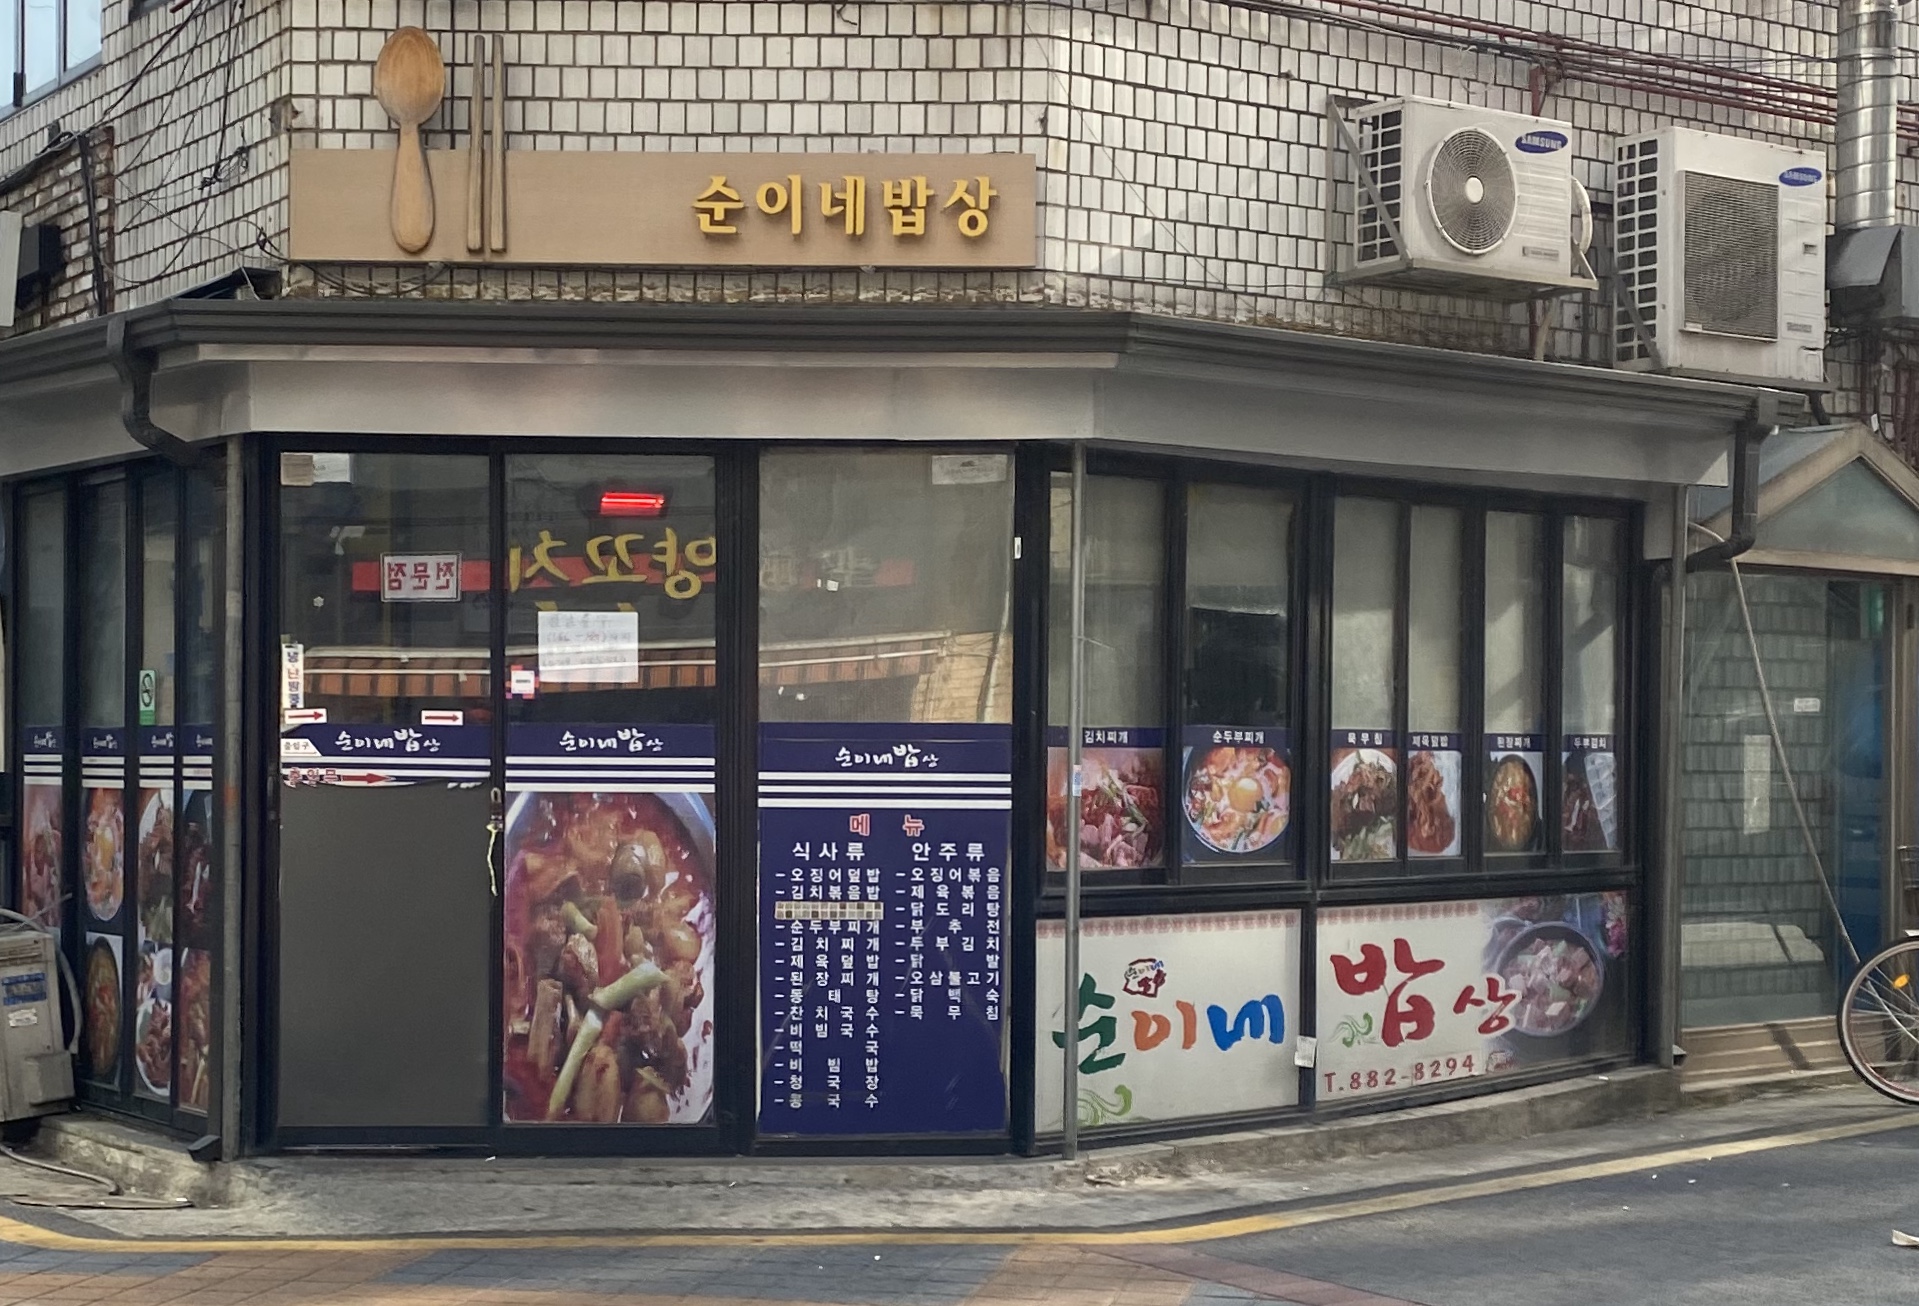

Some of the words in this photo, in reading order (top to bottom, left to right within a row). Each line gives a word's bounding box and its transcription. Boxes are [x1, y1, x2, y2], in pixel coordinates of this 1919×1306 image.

[692, 174, 996, 237] 순이네밥상
[1084, 730, 1129, 744] 김치찌개
[1212, 730, 1265, 745] 순두부찌개
[1324, 1054, 1475, 1093] T.882-8294
